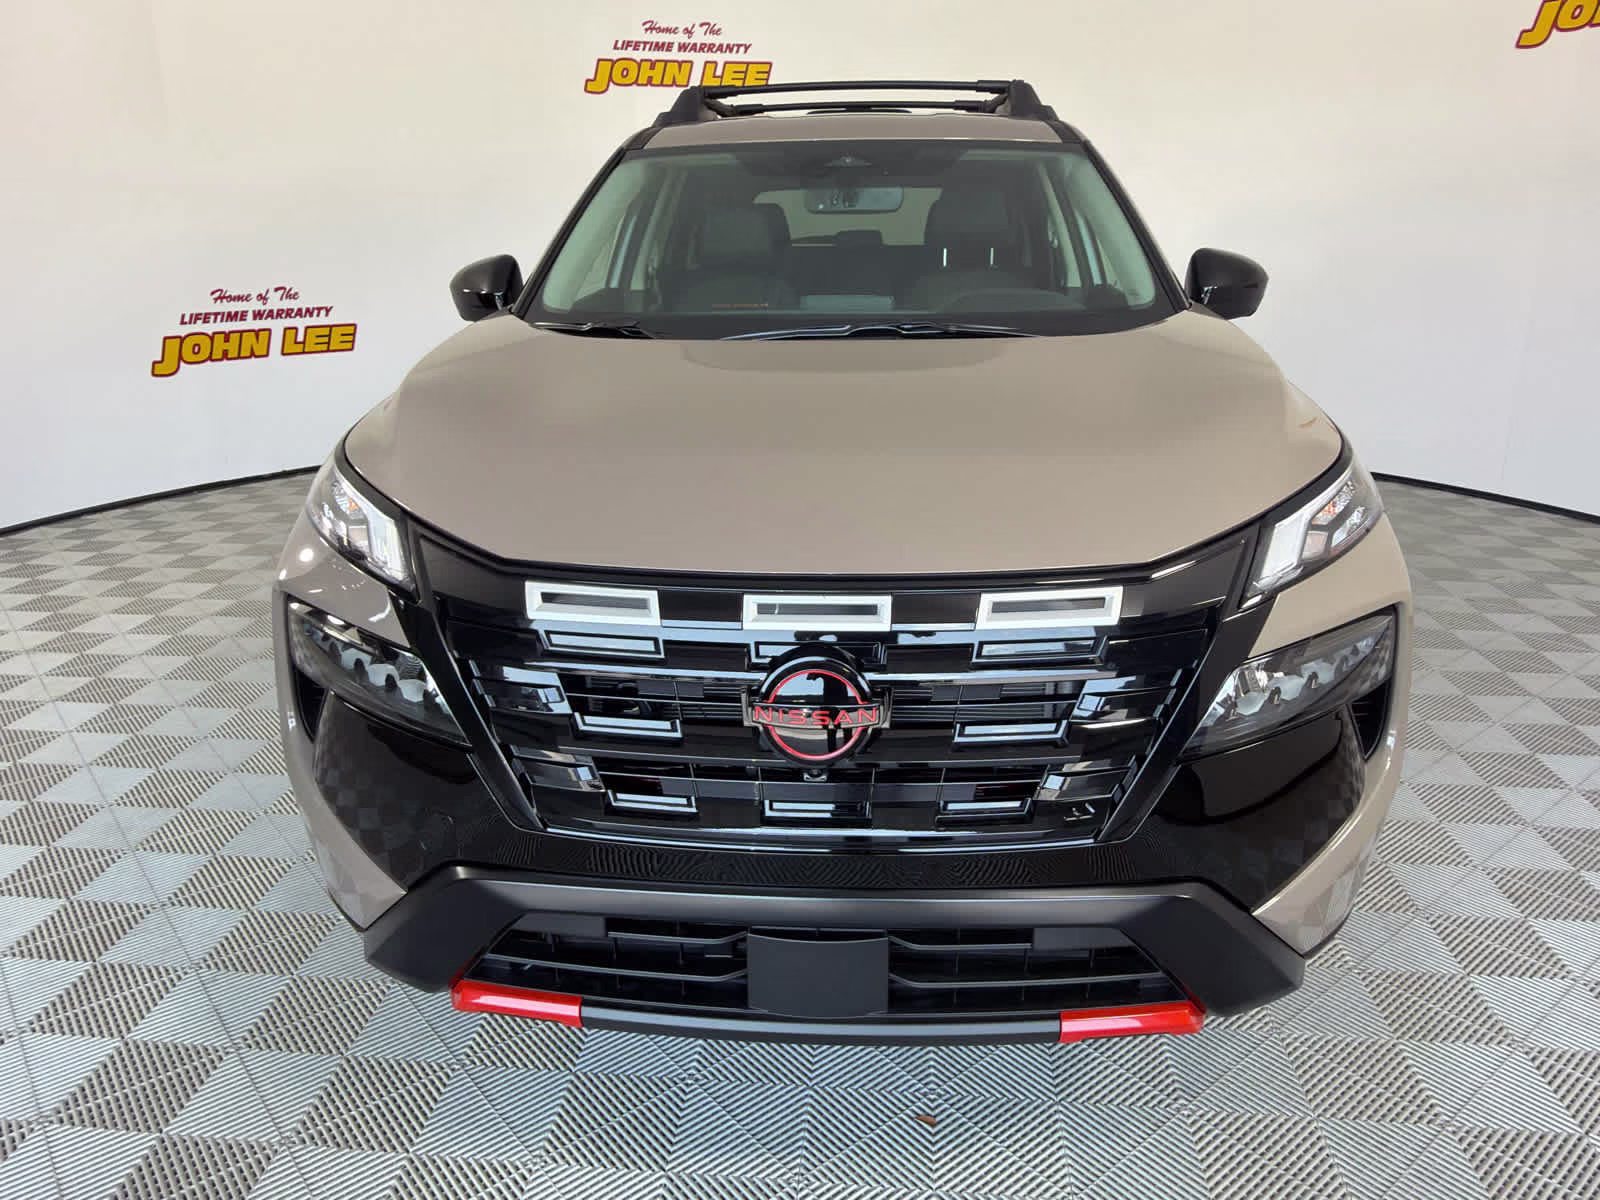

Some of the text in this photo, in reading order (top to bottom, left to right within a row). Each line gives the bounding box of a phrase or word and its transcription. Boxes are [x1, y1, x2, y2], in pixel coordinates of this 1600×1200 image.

[642, 20, 723, 39] Home of The
[1515, 0, 1600, 49] JO
[613, 39, 752, 54] LIFETIME WARRANTY
[584, 57, 772, 94] JOHN LEE
[209, 286, 300, 306] Home of The
[179, 306, 334, 326] LIFETIME WARRANTY
[151, 323, 357, 378] JOHN LEE
[754, 705, 877, 725] NISSAN
